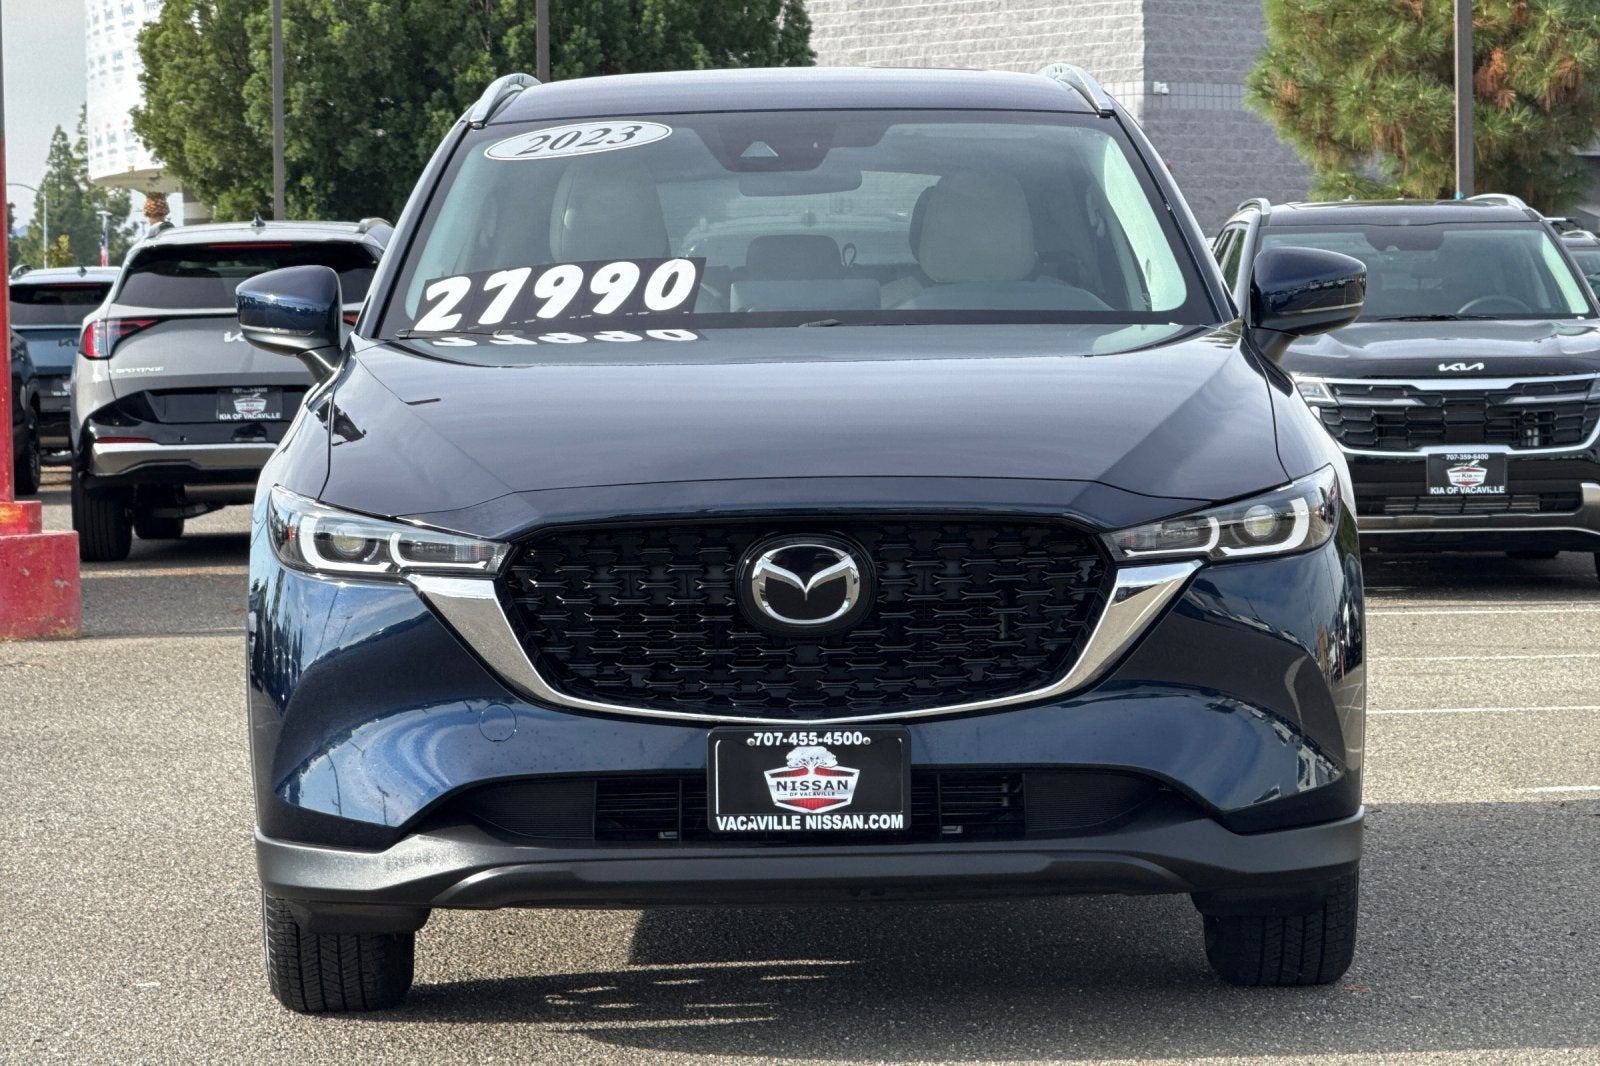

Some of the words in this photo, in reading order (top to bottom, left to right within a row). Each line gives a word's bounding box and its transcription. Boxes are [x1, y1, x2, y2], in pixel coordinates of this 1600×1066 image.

[514, 125, 643, 156] 2023
[414, 258, 696, 331] 27990
[1447, 486, 1458, 494] OF
[1460, 485, 1505, 493] VACAVILLE
[754, 731, 863, 746] 707-455-4500
[776, 780, 848, 791] NISSAN
[716, 815, 801, 831] VACAVILLE
[805, 814, 904, 830] NISSAN.COM
